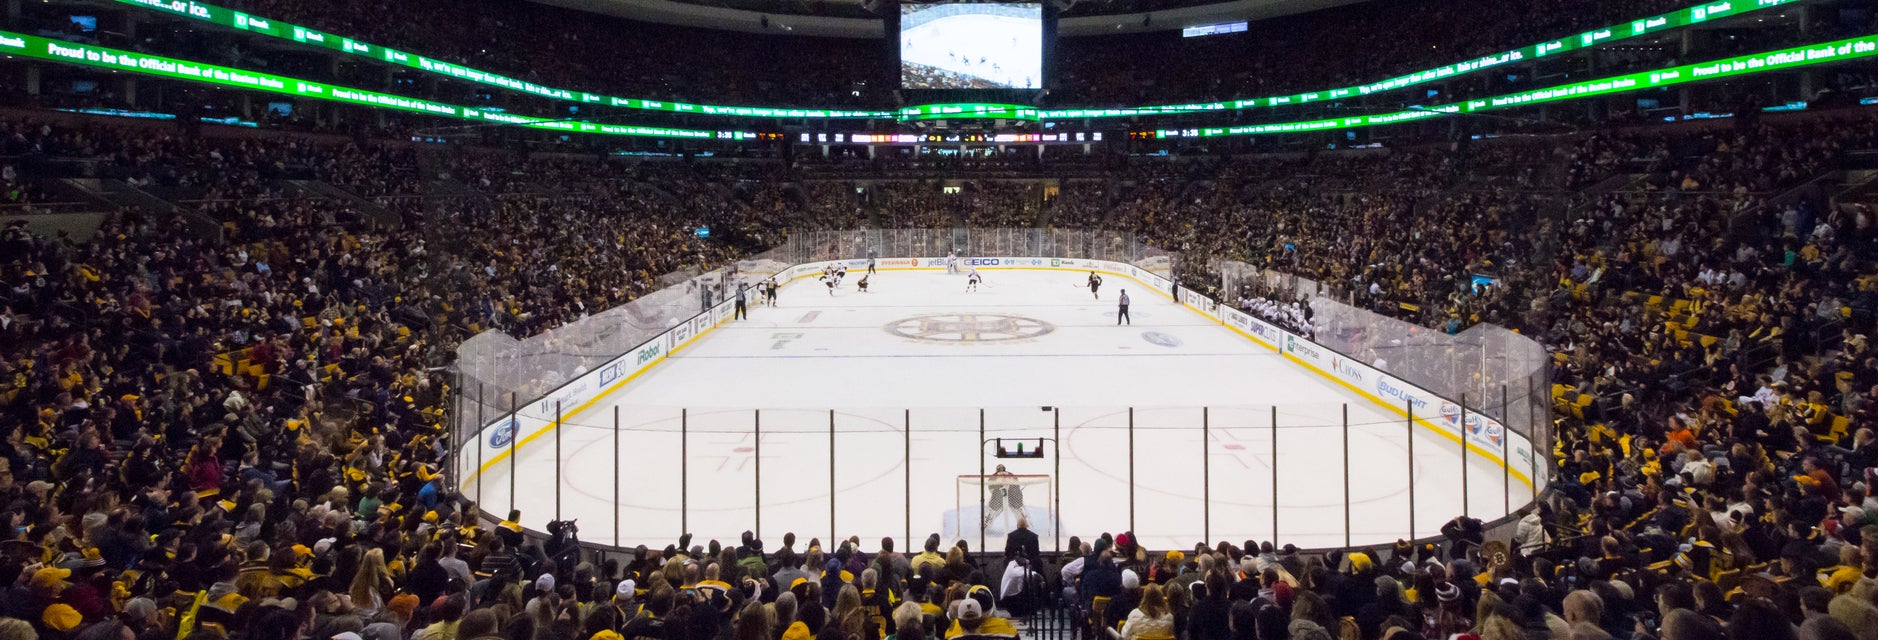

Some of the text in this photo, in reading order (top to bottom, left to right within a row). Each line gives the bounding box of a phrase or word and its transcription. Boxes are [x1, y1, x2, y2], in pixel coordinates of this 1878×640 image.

[189, 1, 211, 18] ice.
[1707, 1, 1731, 13] Bank
[248, 17, 269, 28] Bank
[47, 42, 85, 58] Proud
[86, 50, 101, 60] to
[101, 51, 117, 63] be
[118, 54, 138, 66] the
[138, 57, 176, 72] Official
[177, 63, 201, 75] Bank
[201, 67, 213, 77] of
[213, 69, 229, 80] the
[1693, 40, 1876, 76] Proud to be the Official Bank of the
[637, 341, 660, 366] iRobot
[1379, 381, 1398, 397] BUD
[1441, 405, 1457, 413] Gulf
